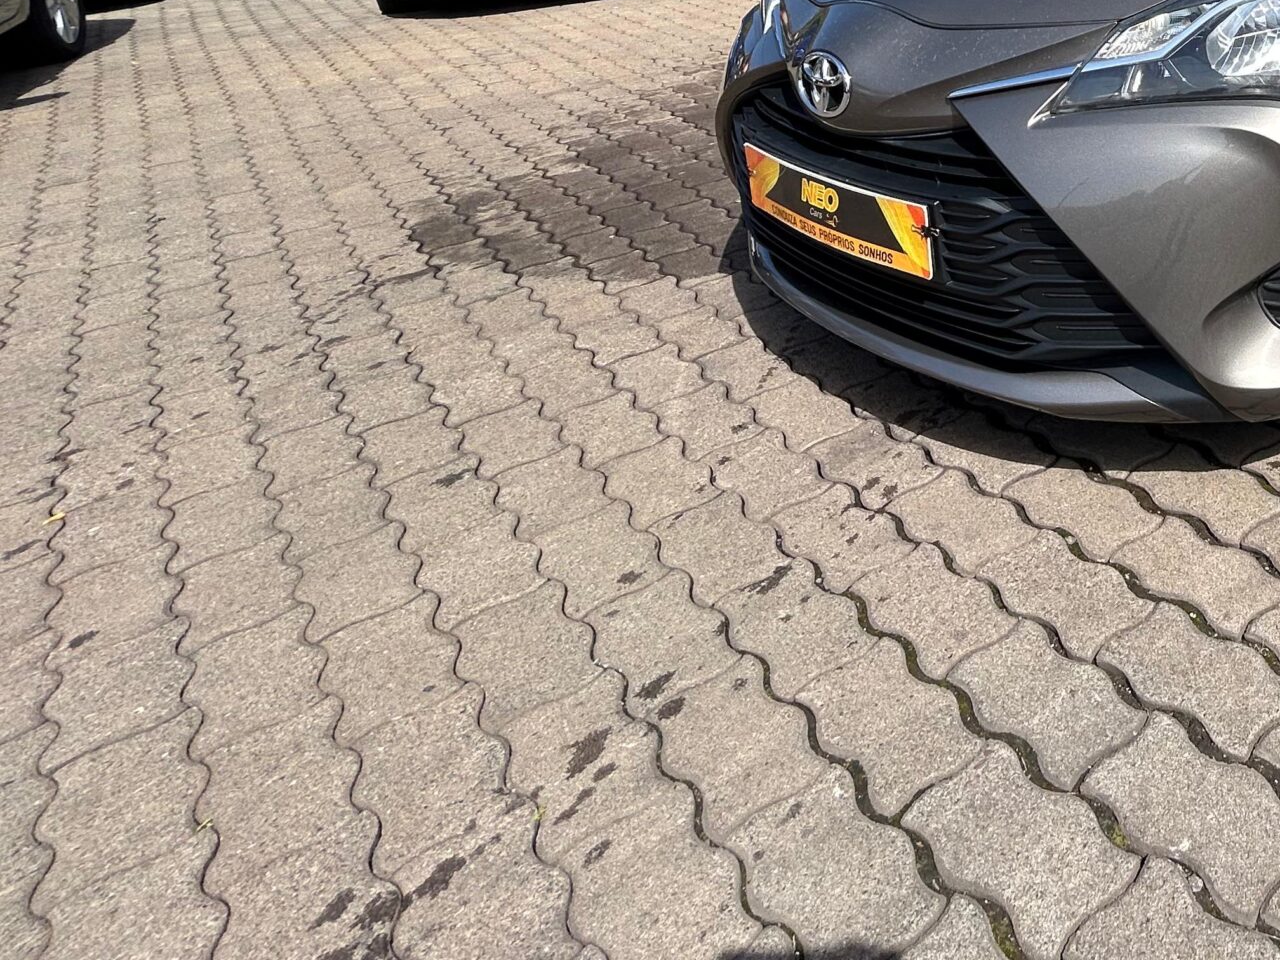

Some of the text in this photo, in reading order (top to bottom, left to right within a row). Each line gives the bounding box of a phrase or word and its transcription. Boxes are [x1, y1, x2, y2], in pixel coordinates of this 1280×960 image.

[801, 178, 840, 212] NEO
[809, 207, 823, 219] Cars
[771, 204, 893, 264] CONDUZA SEUS PRÓPRIOS SONHOS
